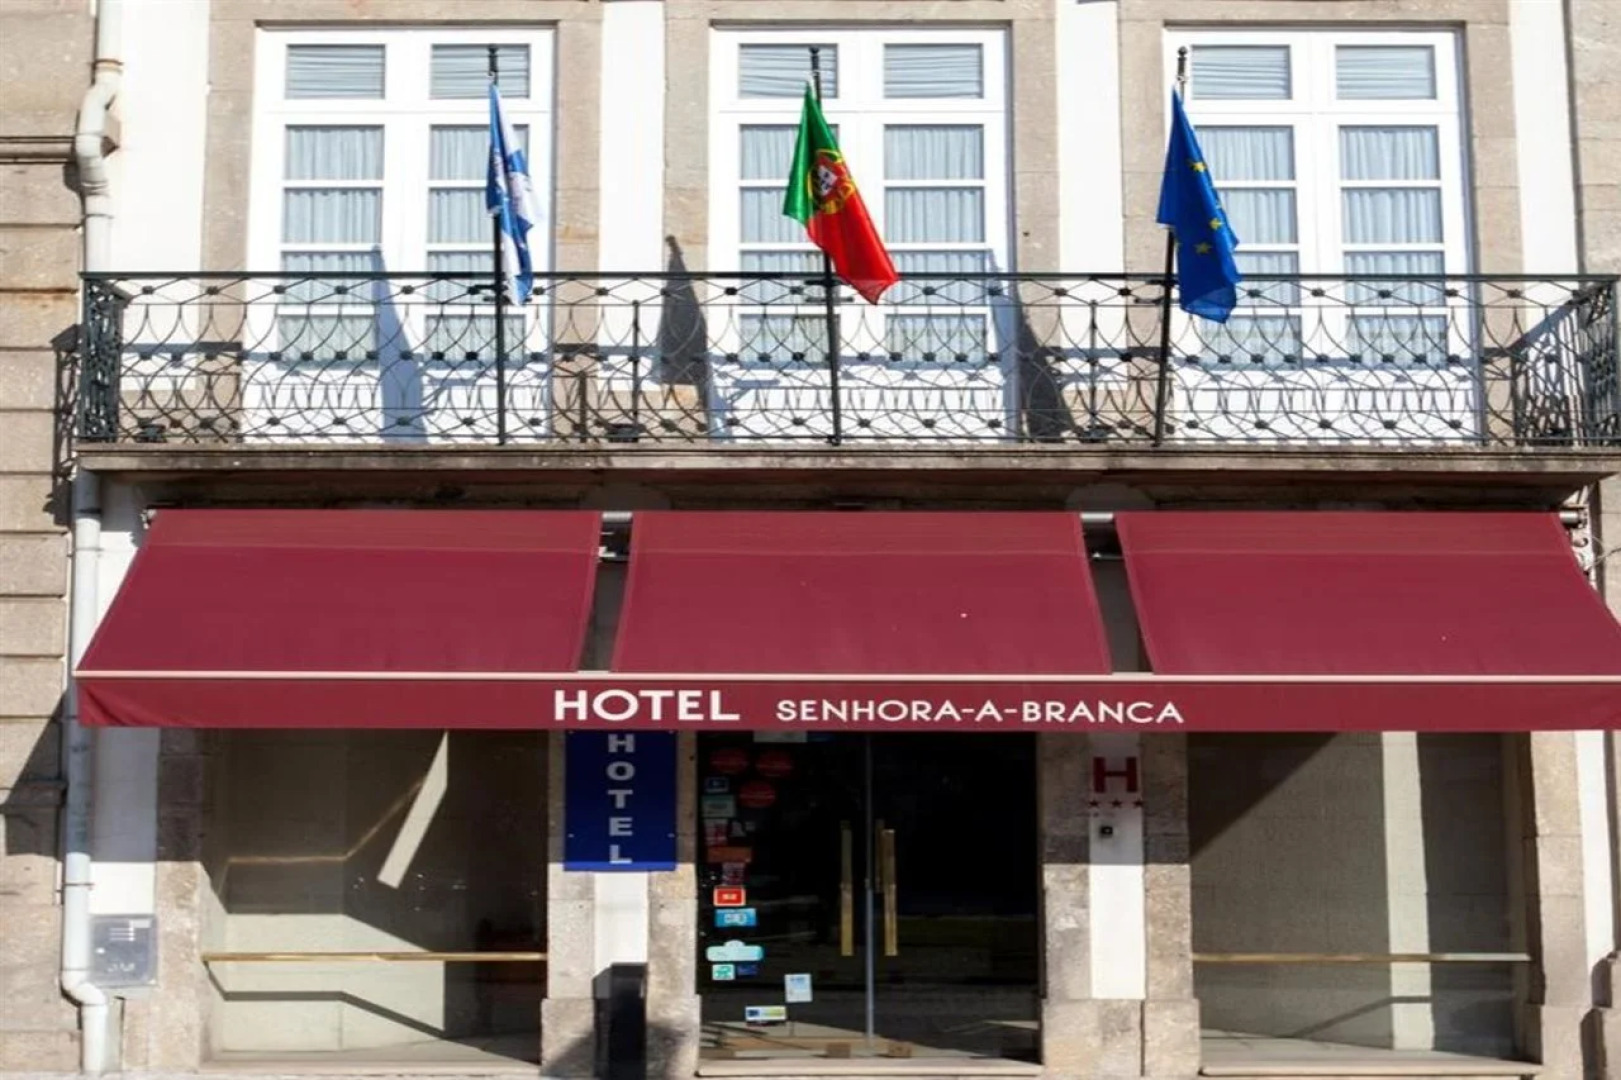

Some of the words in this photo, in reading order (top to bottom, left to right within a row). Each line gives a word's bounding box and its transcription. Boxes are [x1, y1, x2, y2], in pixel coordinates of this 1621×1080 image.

[554, 689, 740, 721] HOTEL
[775, 699, 1184, 724] SENHORA-A-BRANCA
[1093, 756, 1137, 793] H
[606, 733, 635, 864] HOTEL
